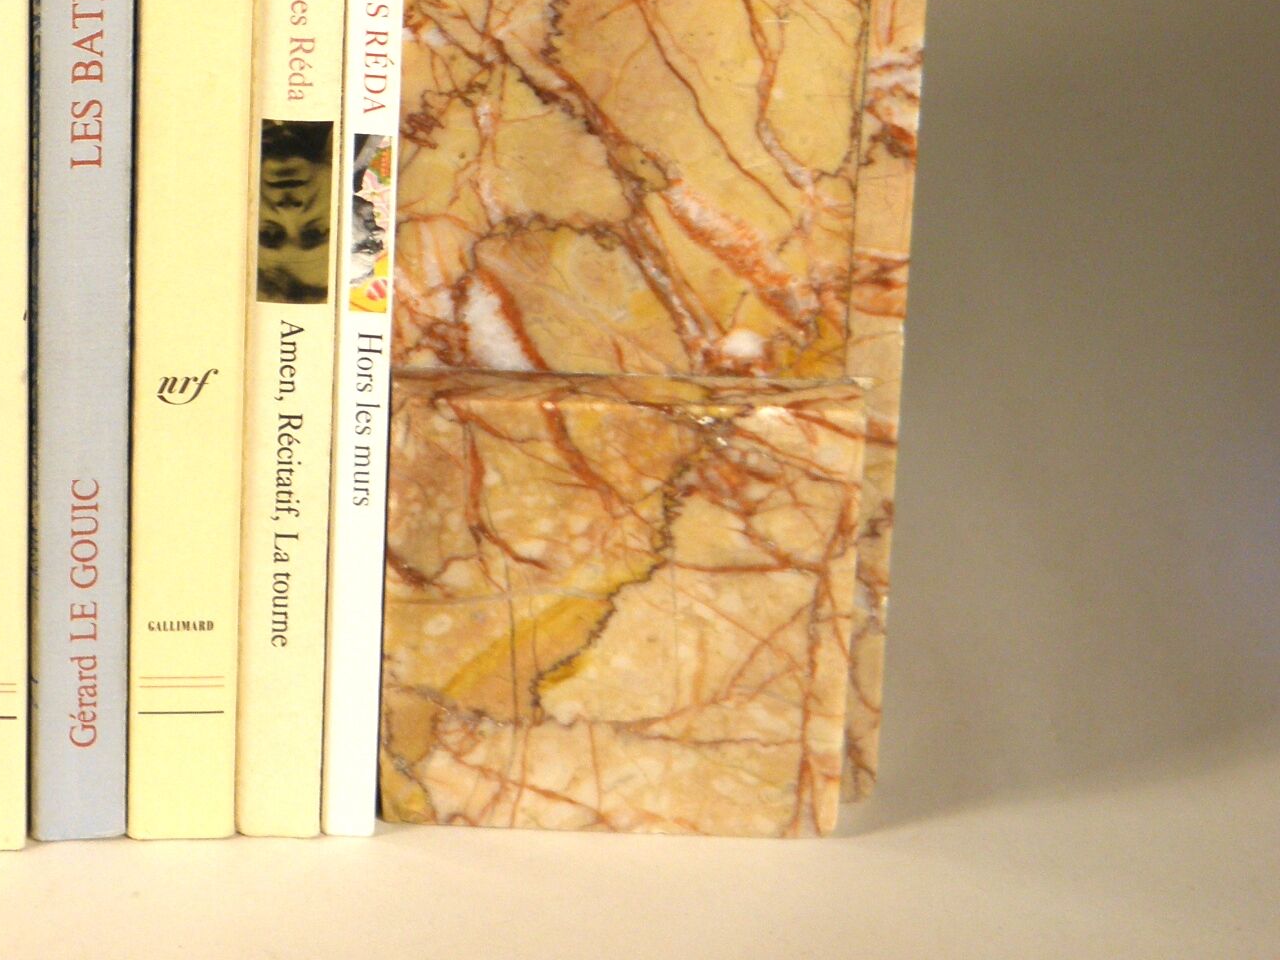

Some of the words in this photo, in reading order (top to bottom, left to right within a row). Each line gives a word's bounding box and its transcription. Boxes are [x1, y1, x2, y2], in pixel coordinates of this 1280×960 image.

[288, 38, 315, 100] Réda
[364, 31, 394, 113] RÉDA
[71, 100, 102, 168] LES
[158, 369, 218, 404] nrf
[274, 319, 304, 401] Amen,
[357, 334, 383, 392] Hors
[356, 403, 380, 435] les
[272, 414, 303, 520] Récitatif,
[354, 446, 370, 506] murs
[70, 480, 99, 589] GOUIC
[274, 533, 299, 562] La
[70, 602, 97, 641] LE
[148, 621, 214, 631] GALLIMARD
[271, 572, 291, 647] tourne
[69, 655, 98, 748] Gérard
